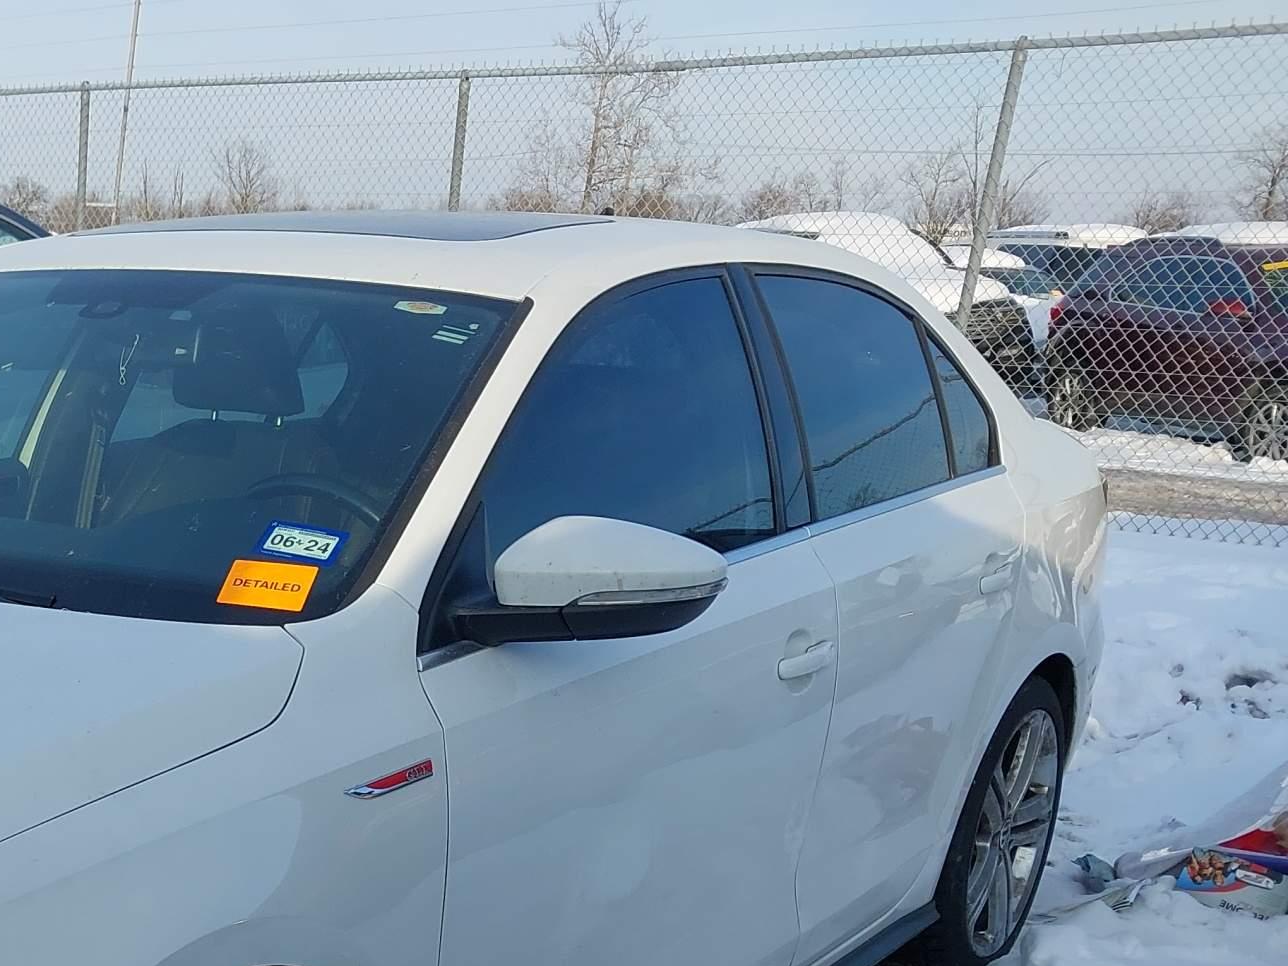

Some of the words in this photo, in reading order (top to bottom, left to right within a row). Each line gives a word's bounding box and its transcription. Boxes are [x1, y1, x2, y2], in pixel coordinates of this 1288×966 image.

[270, 533, 297, 548] 06
[303, 539, 332, 555] 24
[232, 577, 301, 593] DETAILED
